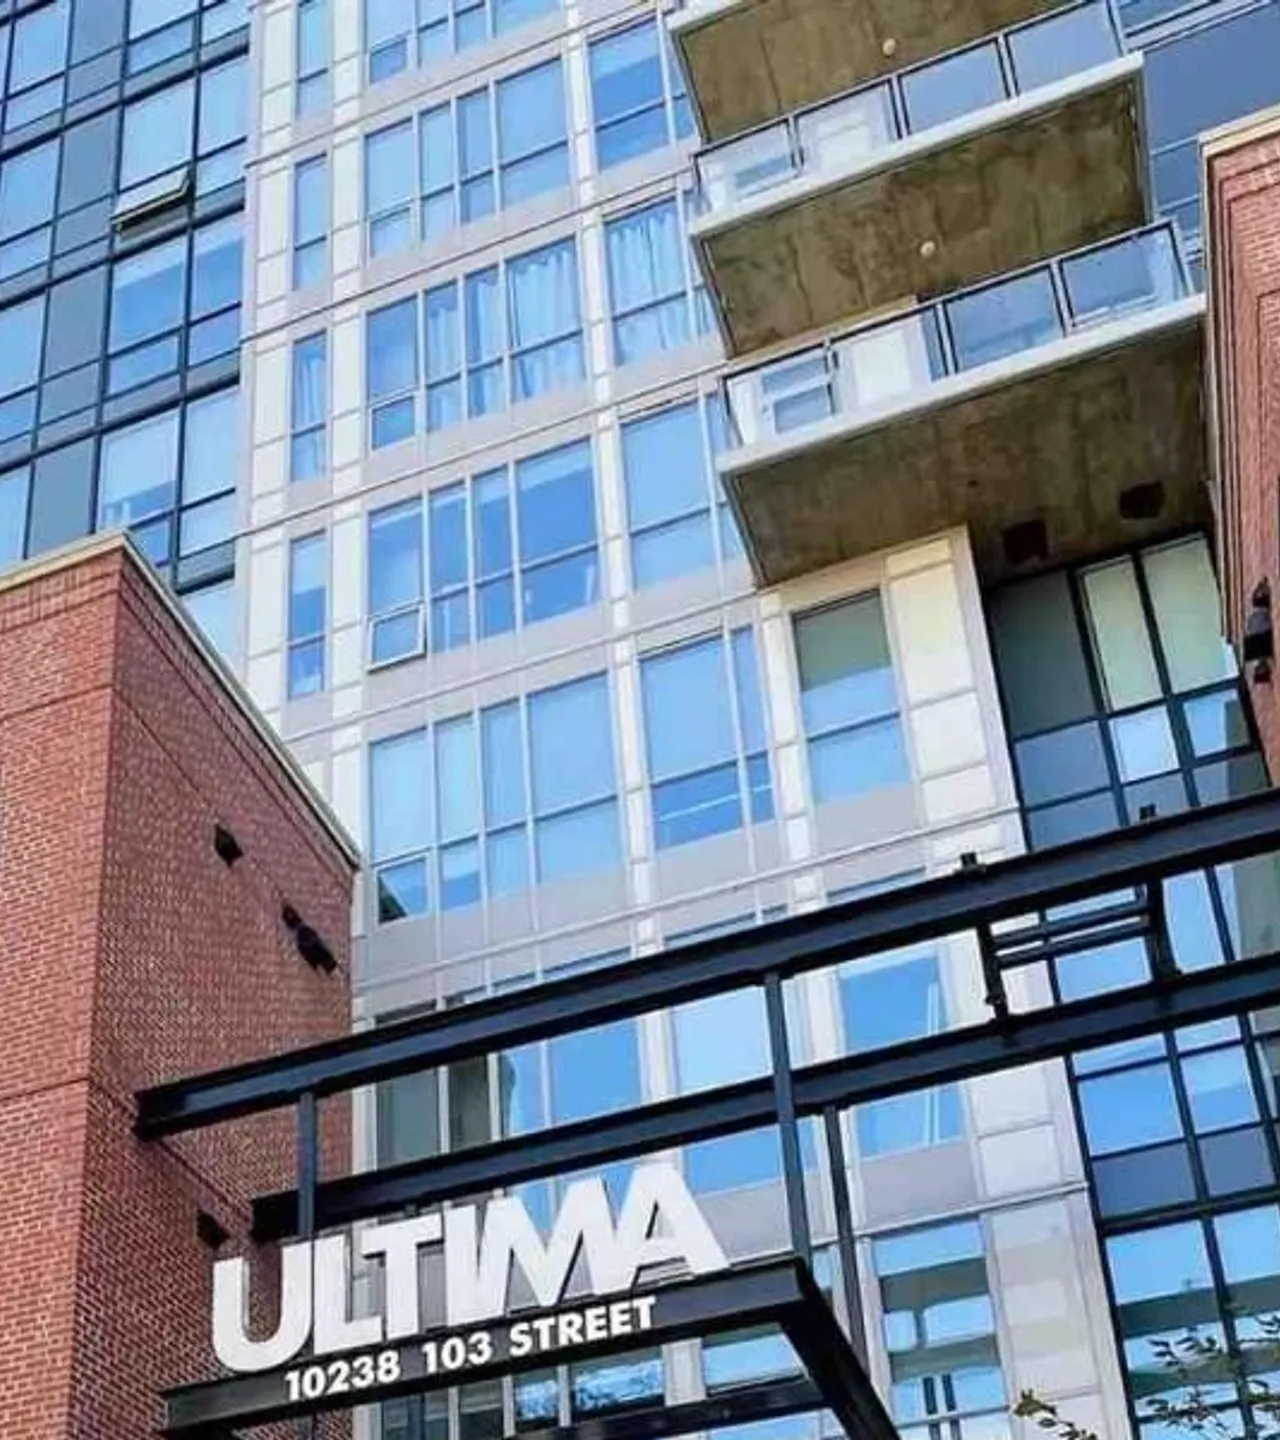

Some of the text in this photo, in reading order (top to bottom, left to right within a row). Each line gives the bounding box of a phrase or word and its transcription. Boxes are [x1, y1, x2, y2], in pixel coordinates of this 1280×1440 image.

[211, 1149, 729, 1373] ULTIMA
[285, 1297, 657, 1402] 10238 103 STREET
